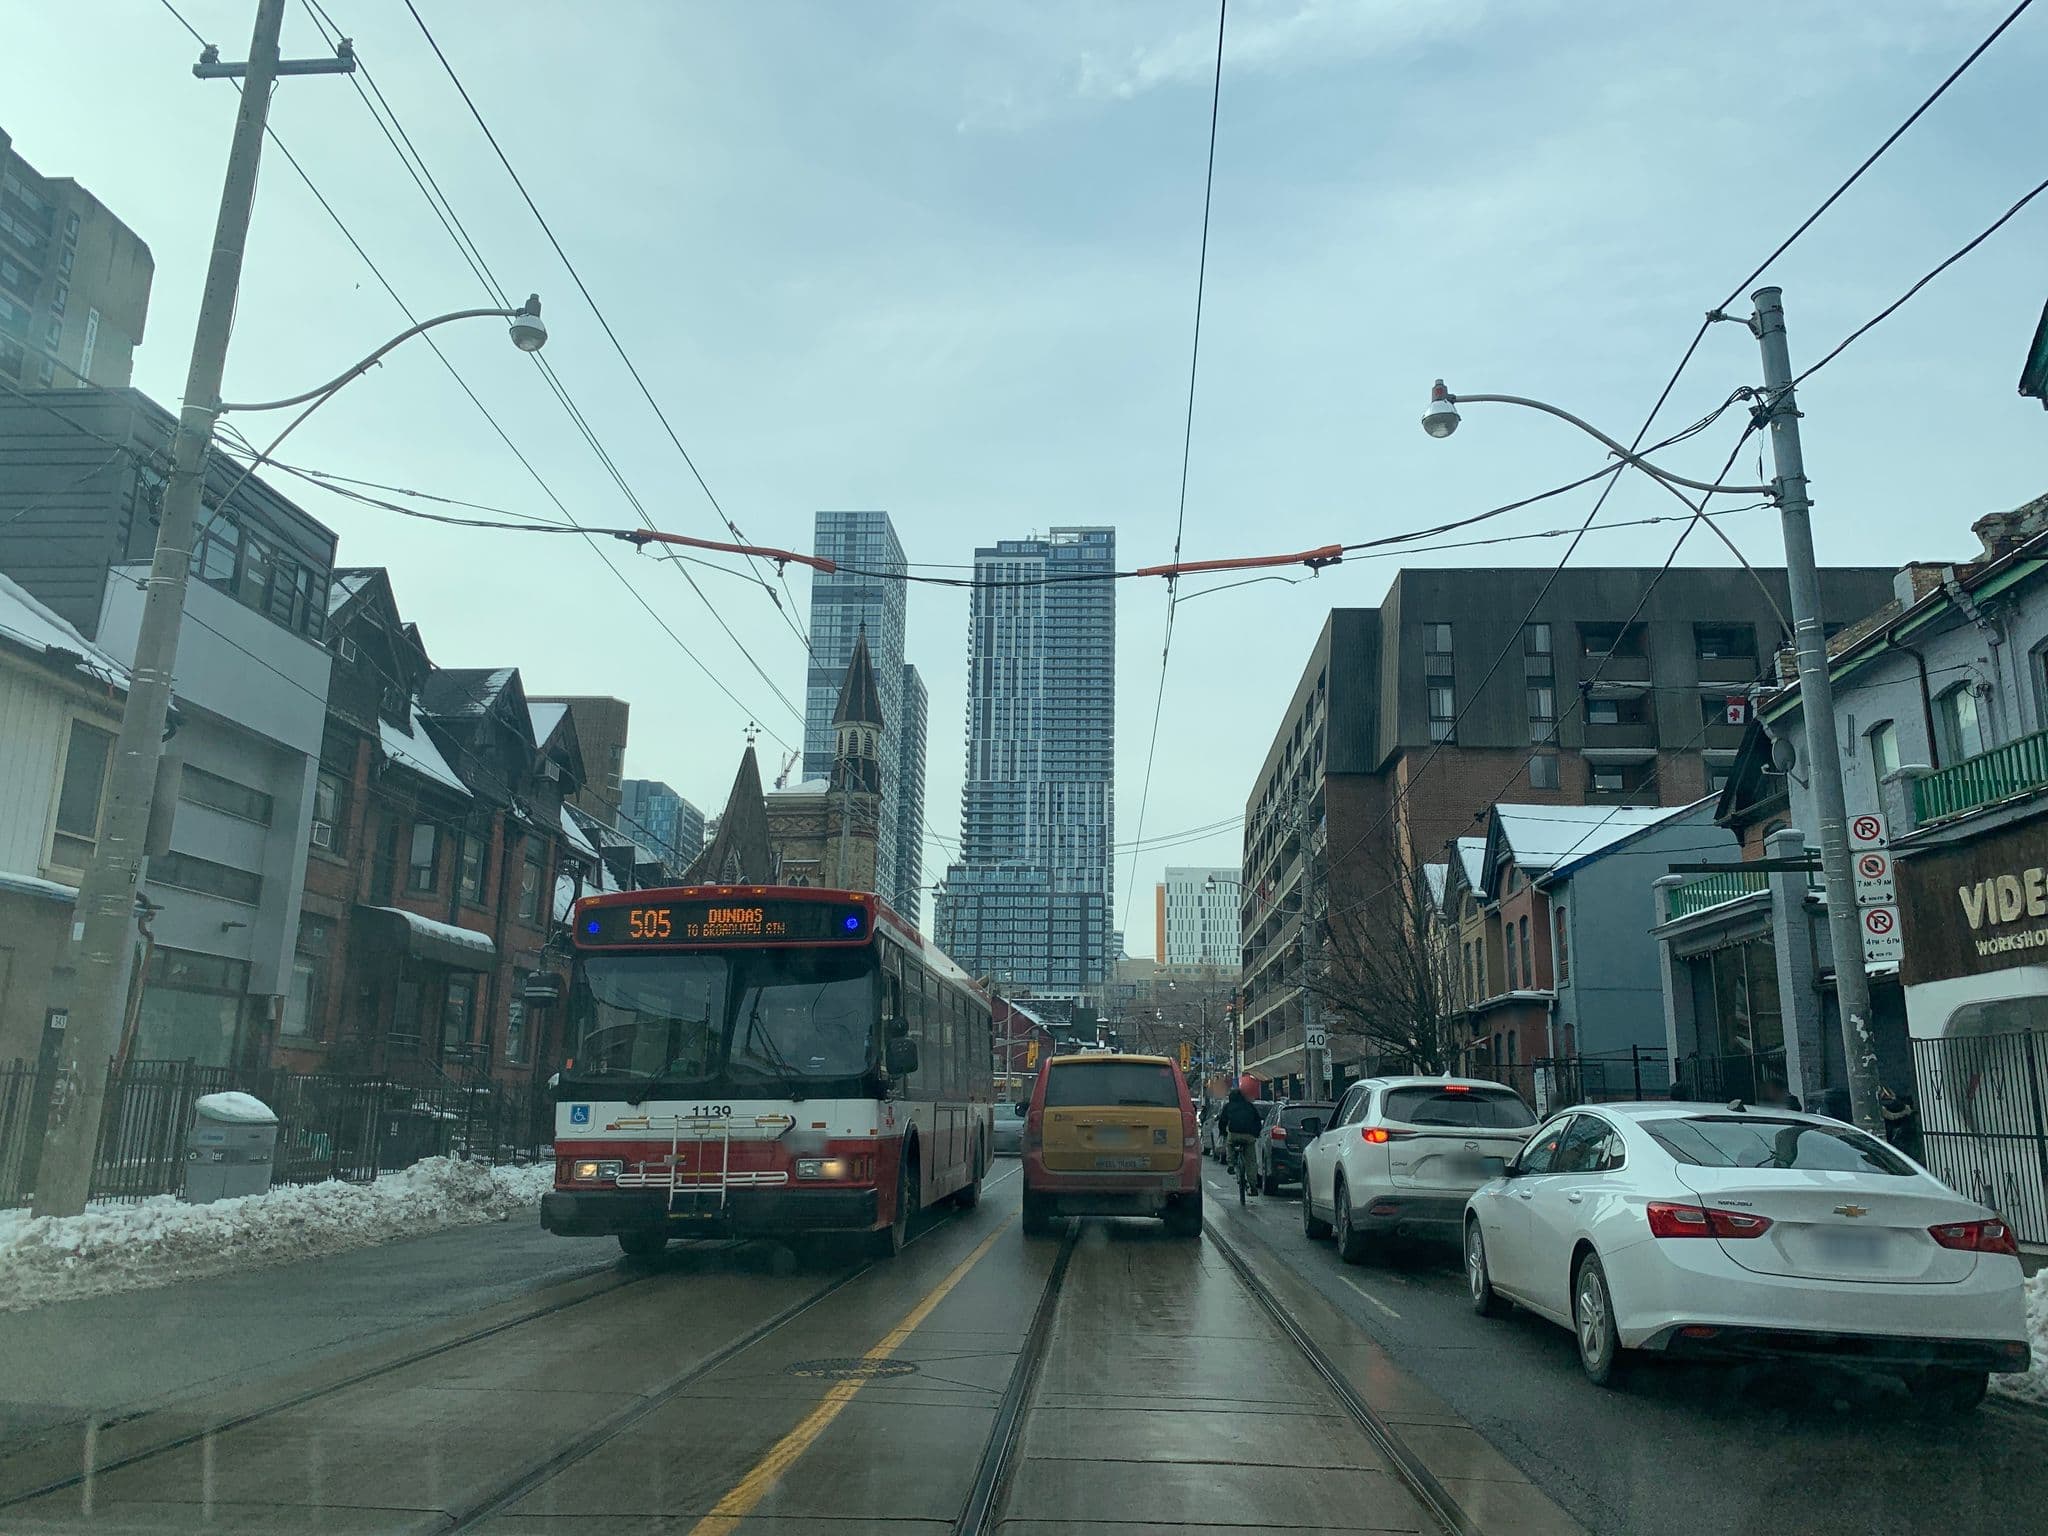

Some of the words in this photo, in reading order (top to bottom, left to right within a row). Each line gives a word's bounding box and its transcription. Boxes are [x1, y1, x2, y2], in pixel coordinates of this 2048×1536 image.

[1958, 867, 2048, 930] VIDE
[629, 909, 671, 938] 505
[707, 908, 763, 923] DUNDAS
[1975, 928, 2048, 956] WORKSHO
[1308, 1034, 1326, 1046] 40
[692, 1105, 732, 1118] 1139
